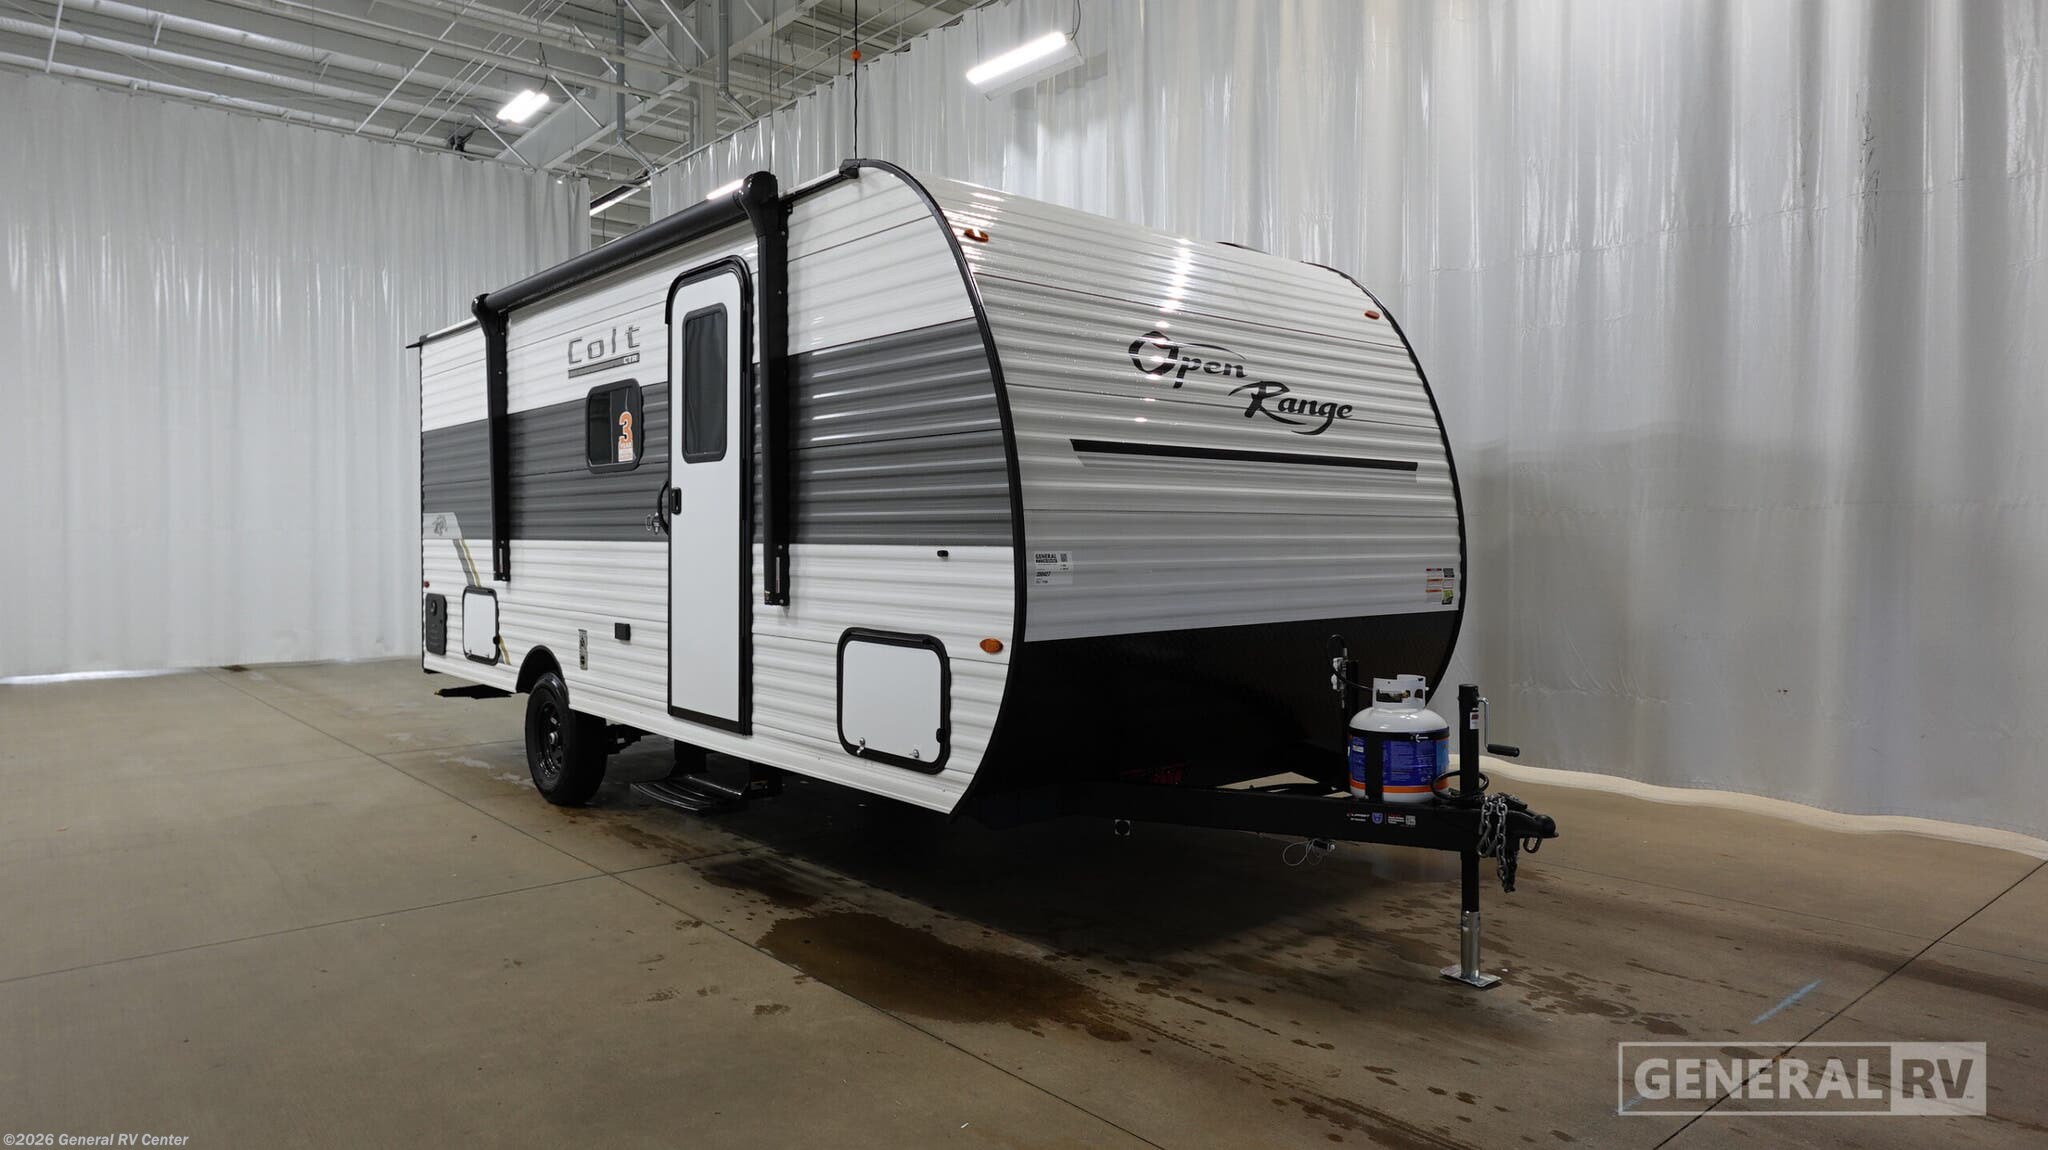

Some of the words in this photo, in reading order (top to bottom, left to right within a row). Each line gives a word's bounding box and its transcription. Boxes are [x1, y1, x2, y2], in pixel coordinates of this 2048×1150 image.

[568, 326, 640, 364] Colt
[623, 355, 639, 364] CTR
[1128, 330, 1248, 389] Open
[1228, 380, 1353, 436] Range
[618, 411, 633, 444] 3
